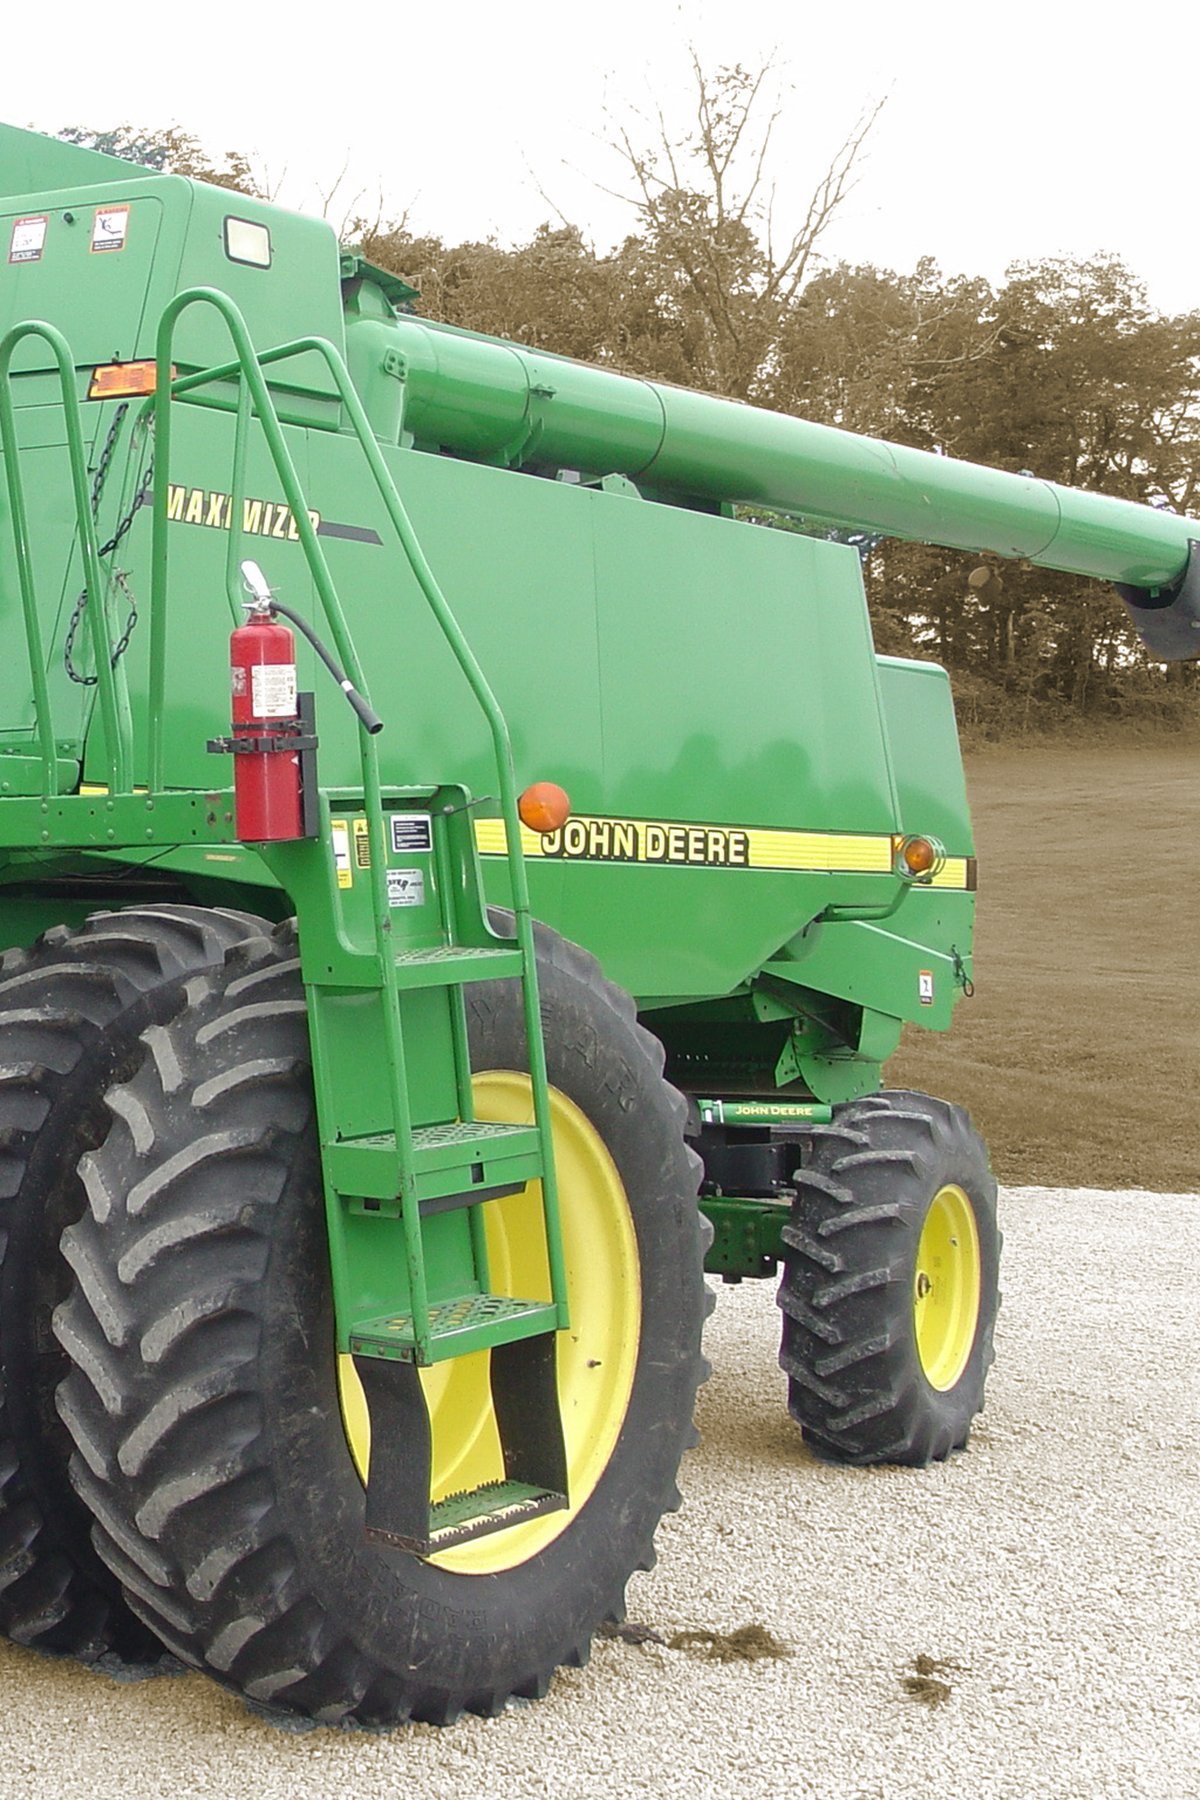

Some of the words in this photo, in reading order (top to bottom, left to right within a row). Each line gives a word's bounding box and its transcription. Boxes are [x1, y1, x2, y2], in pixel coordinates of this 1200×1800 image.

[541, 819, 638, 860] JOHN
[645, 824, 749, 867] DEERE
[735, 1106, 769, 1116] JOHN
[771, 1106, 813, 1116] DEERE
